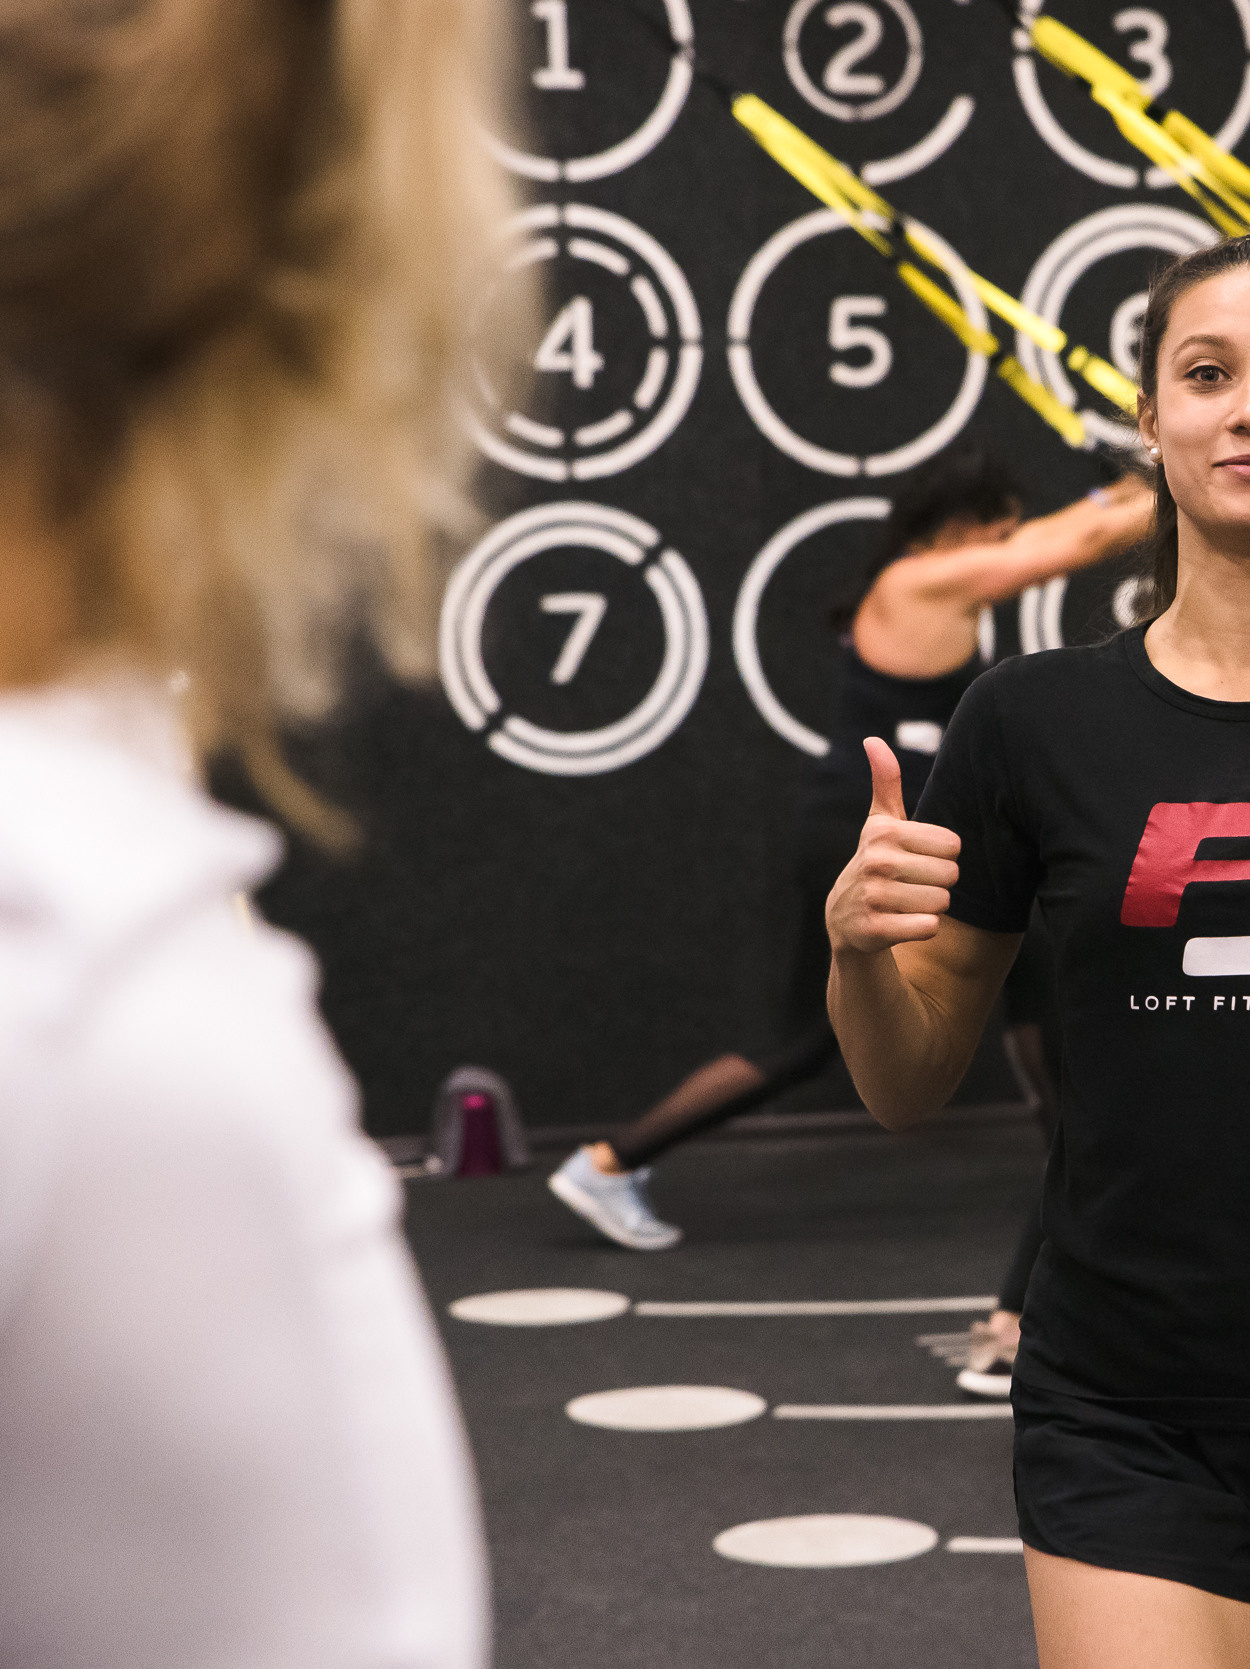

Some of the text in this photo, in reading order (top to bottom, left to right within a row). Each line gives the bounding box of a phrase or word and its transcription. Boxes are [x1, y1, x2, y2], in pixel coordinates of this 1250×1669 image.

[531, 0, 586, 90] 1
[822, 2, 885, 95] 2
[1111, 7, 1174, 98] 3
[533, 294, 605, 390] 4
[828, 295, 893, 388] 5
[539, 591, 608, 685] 7
[1130, 995, 1196, 1011] LOFT
